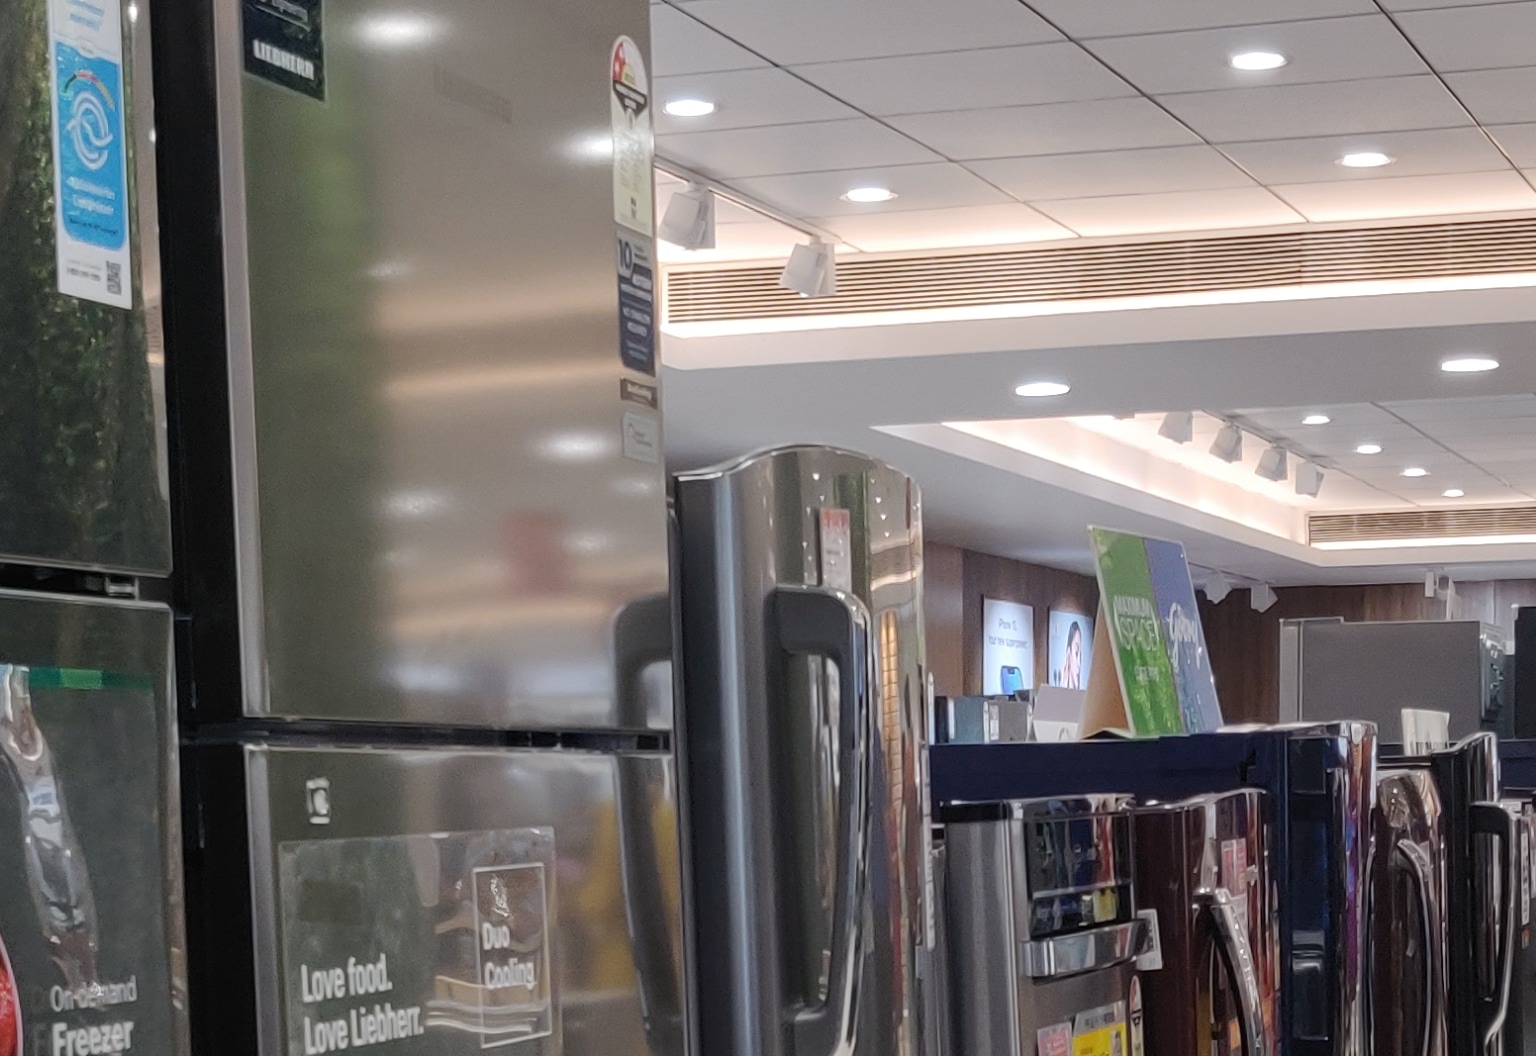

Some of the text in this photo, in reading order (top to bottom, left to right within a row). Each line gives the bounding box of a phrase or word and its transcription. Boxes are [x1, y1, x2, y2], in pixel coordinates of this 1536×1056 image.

[481, 922, 511, 950] Duo
[49, 974, 139, 1013] On-demand
[301, 953, 393, 1004] Love food.
[484, 958, 536, 991] Cooling
[304, 1002, 425, 1056] Love Liebherr.
